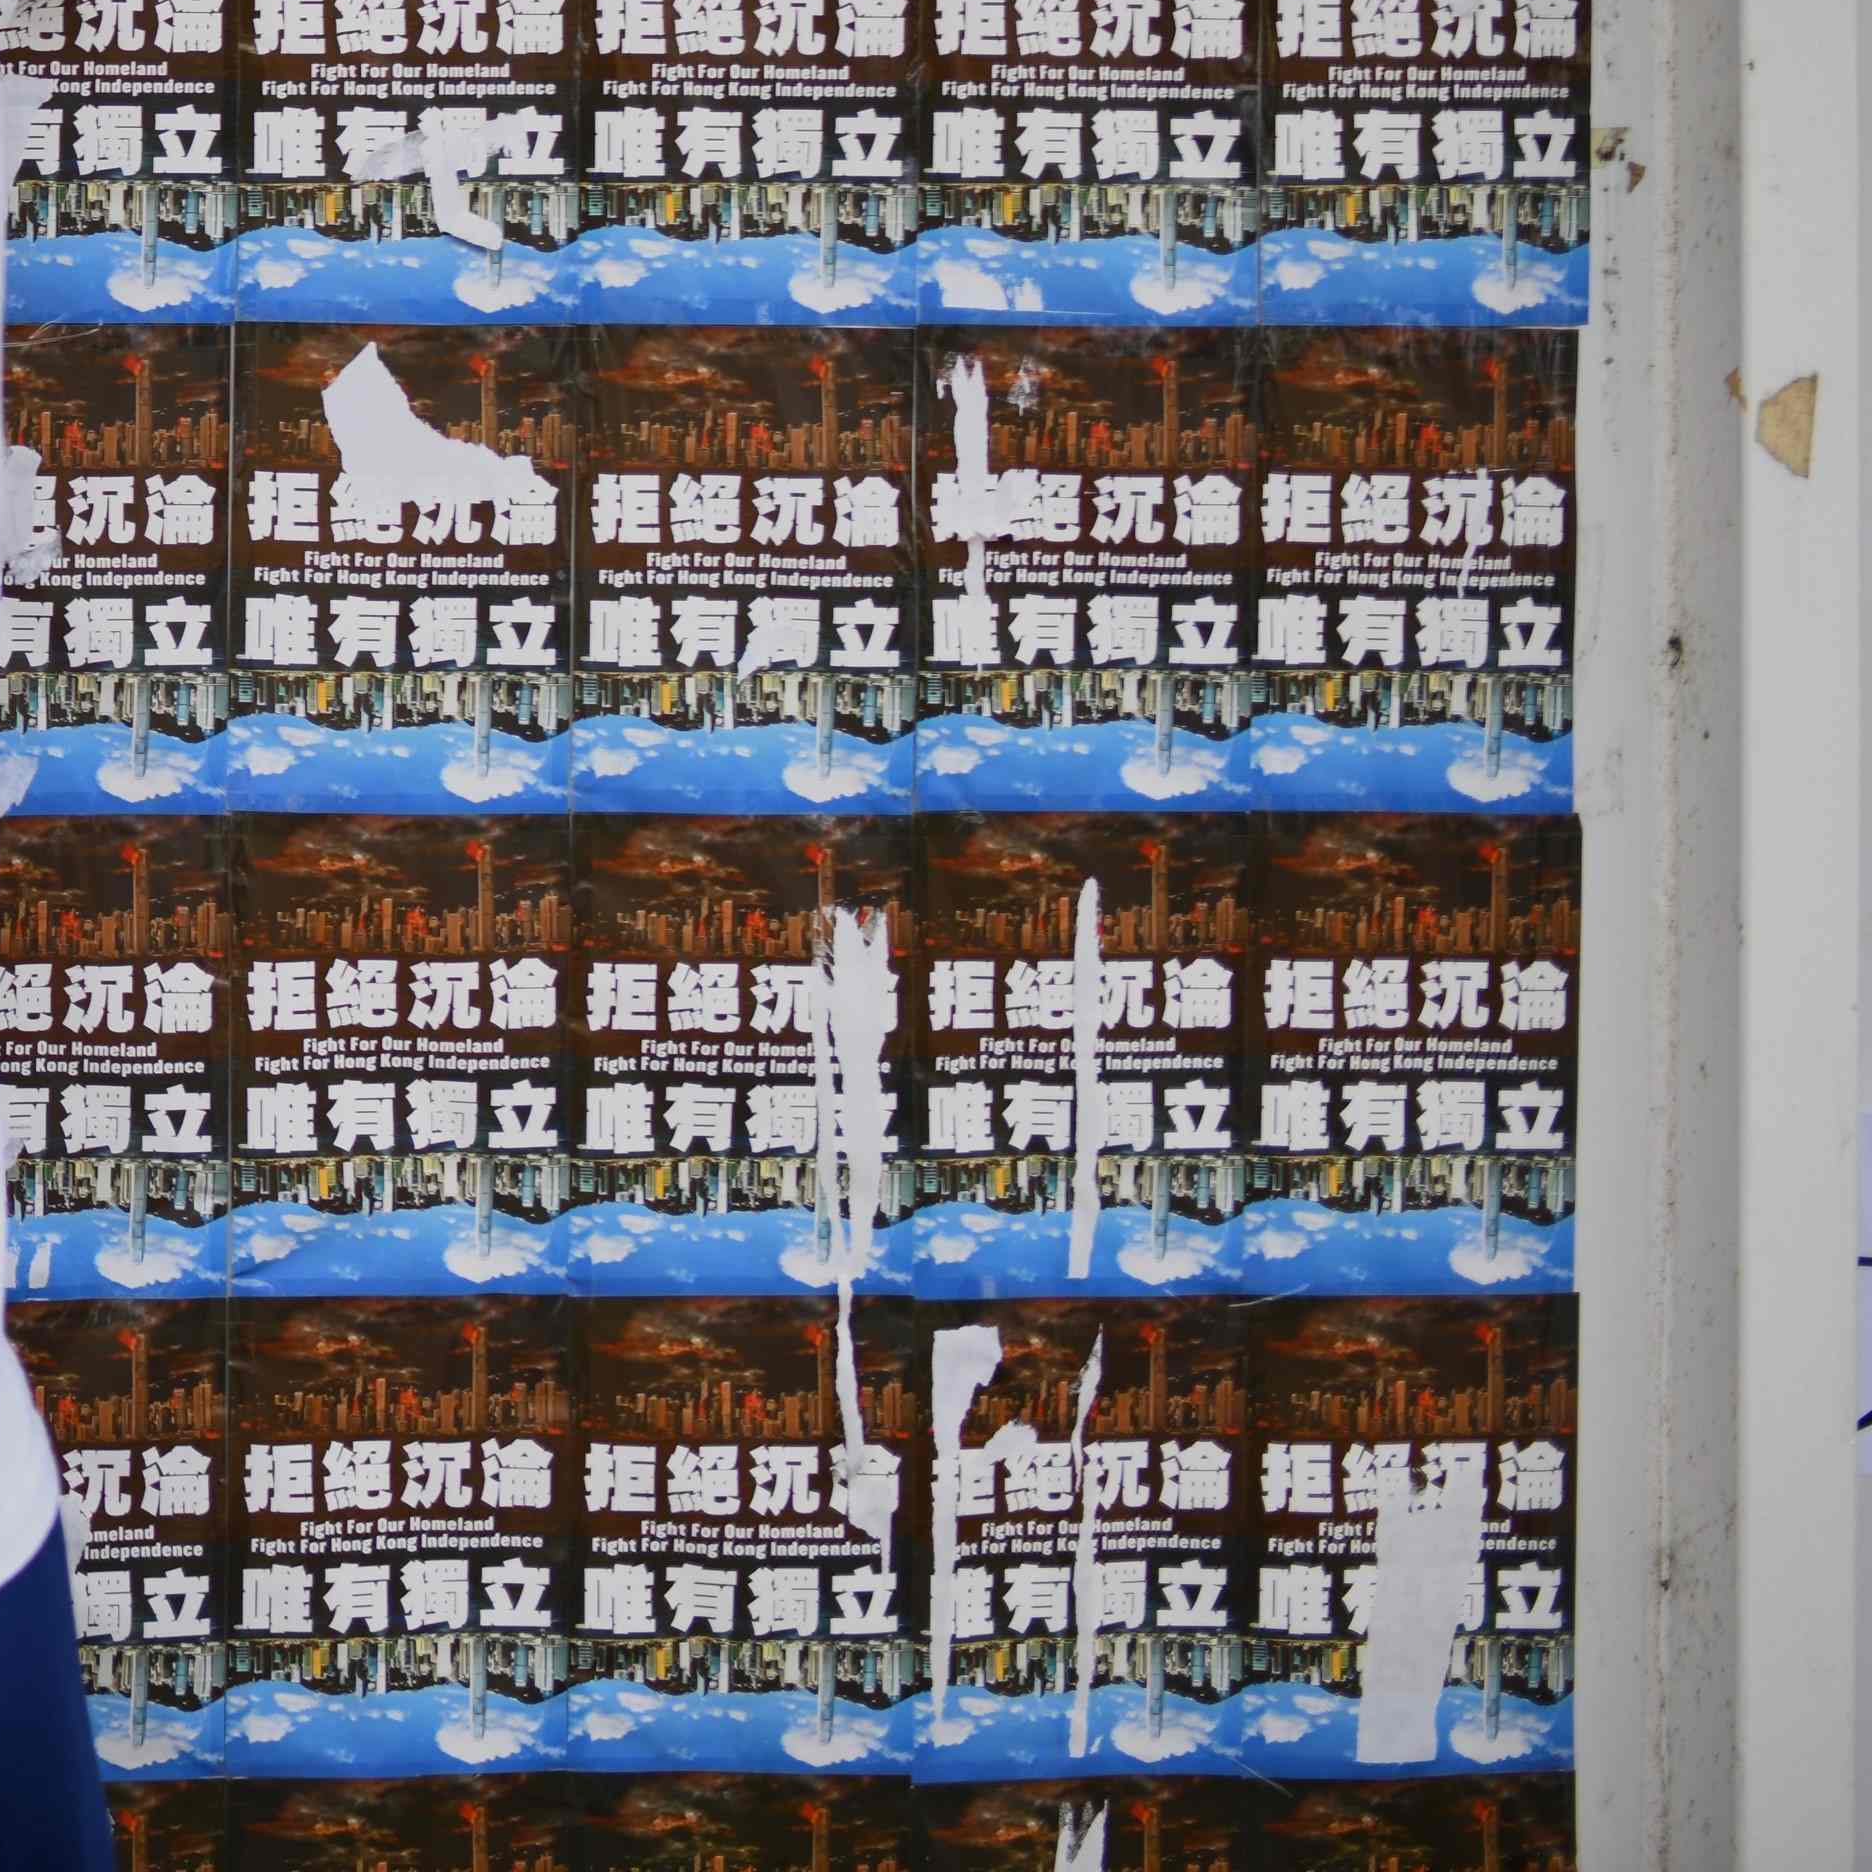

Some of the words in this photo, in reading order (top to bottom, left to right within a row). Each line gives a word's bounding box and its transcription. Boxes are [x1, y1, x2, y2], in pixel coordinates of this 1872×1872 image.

[593, 107, 903, 178] 唯有獨立
[933, 108, 1241, 180] 唯有獨立
[247, 958, 557, 1031] 拒絕沉淪
[1264, 960, 1568, 1030] 拒絕沉淪
[255, 1056, 299, 1074] Fight
[303, 1056, 330, 1071] For
[334, 1055, 376, 1071] Hong
[380, 1054, 424, 1071] Kong
[428, 1055, 549, 1072] Independence
[303, 1038, 345, 1055] Fight
[350, 1037, 377, 1051] For
[382, 1036, 410, 1051] Our
[416, 1037, 504, 1052] Homeland
[245, 1079, 557, 1153] 唯有獨立
[1262, 1080, 1563, 1151] 唯有獨立
[244, 1438, 553, 1513] 拒絕沉淪
[242, 1558, 551, 1633] 唯有獨立
